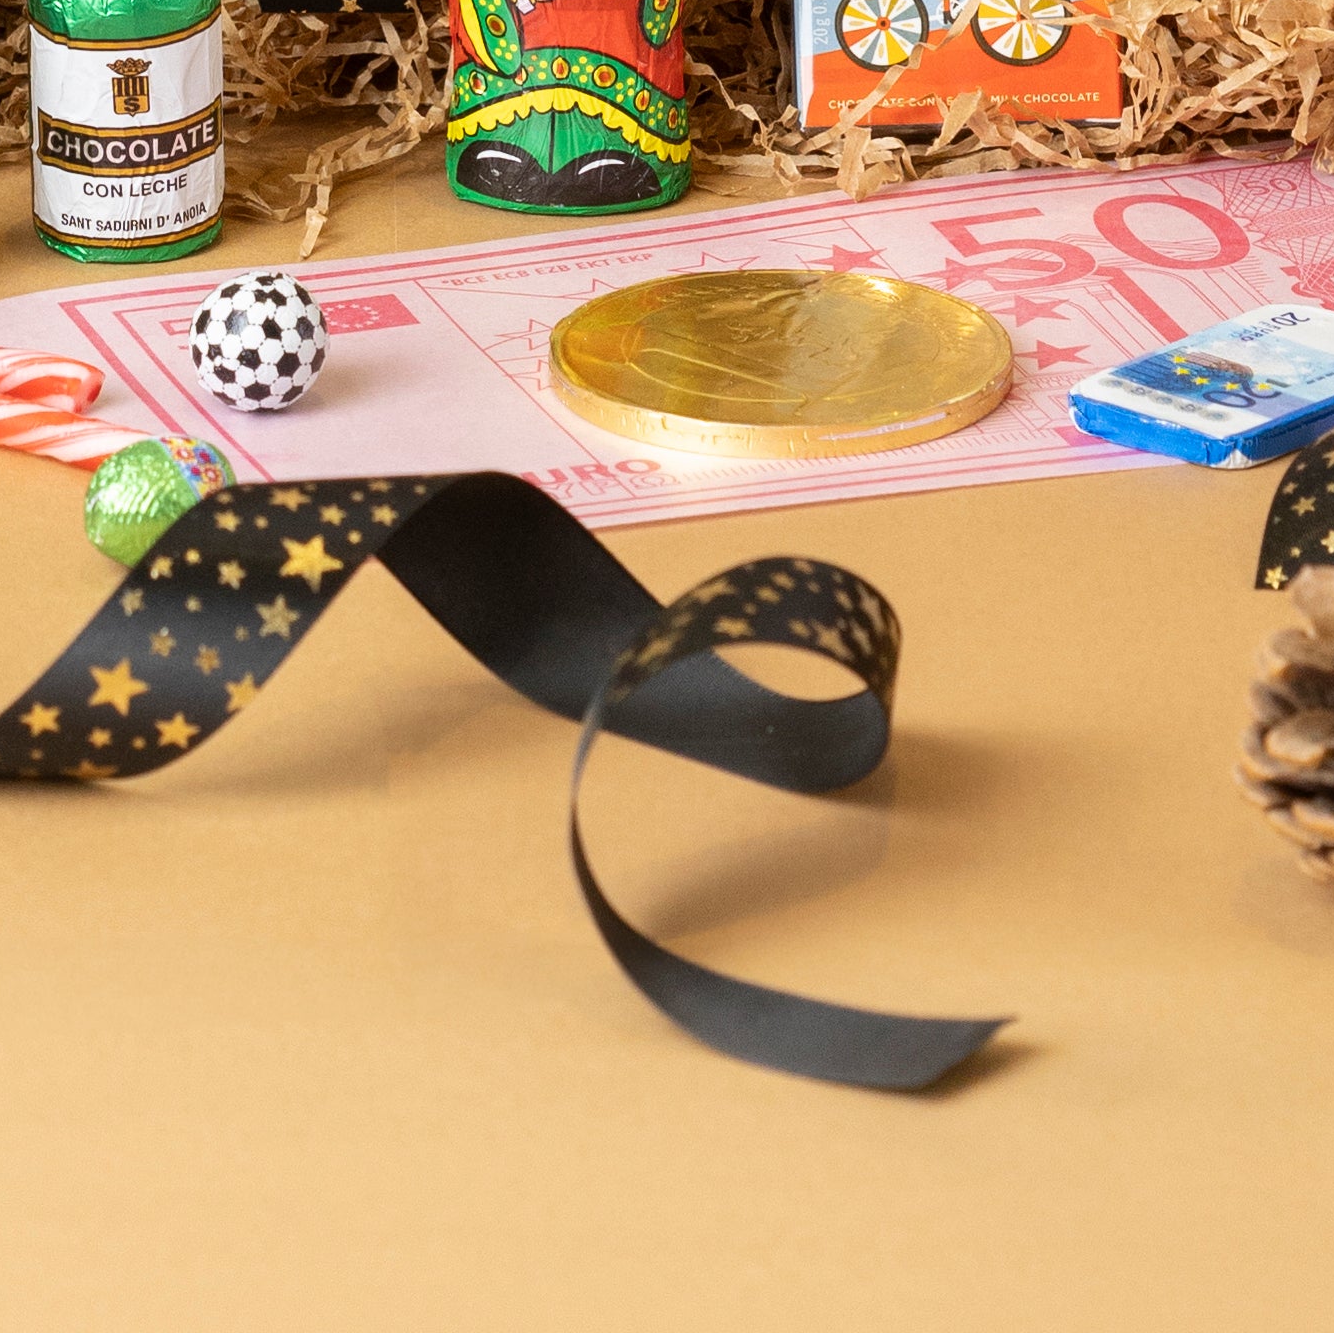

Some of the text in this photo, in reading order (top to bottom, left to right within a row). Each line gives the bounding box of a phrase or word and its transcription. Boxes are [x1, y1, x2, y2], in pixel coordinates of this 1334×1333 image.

[1023, 91, 1100, 104] CHOCOLATE
[47, 117, 215, 163] CHOCOLATE
[83, 173, 188, 197] CON LECHE
[1242, 177, 1298, 195] 50
[61, 213, 91, 231] SANT
[96, 218, 152, 231] SADURNI
[174, 201, 207, 224] ANOIA
[930, 194, 1251, 291] 50
[535, 264, 571, 275] EZB
[576, 259, 611, 270] EKT
[1271, 312, 1310, 326] 20
[521, 459, 661, 485] URO
